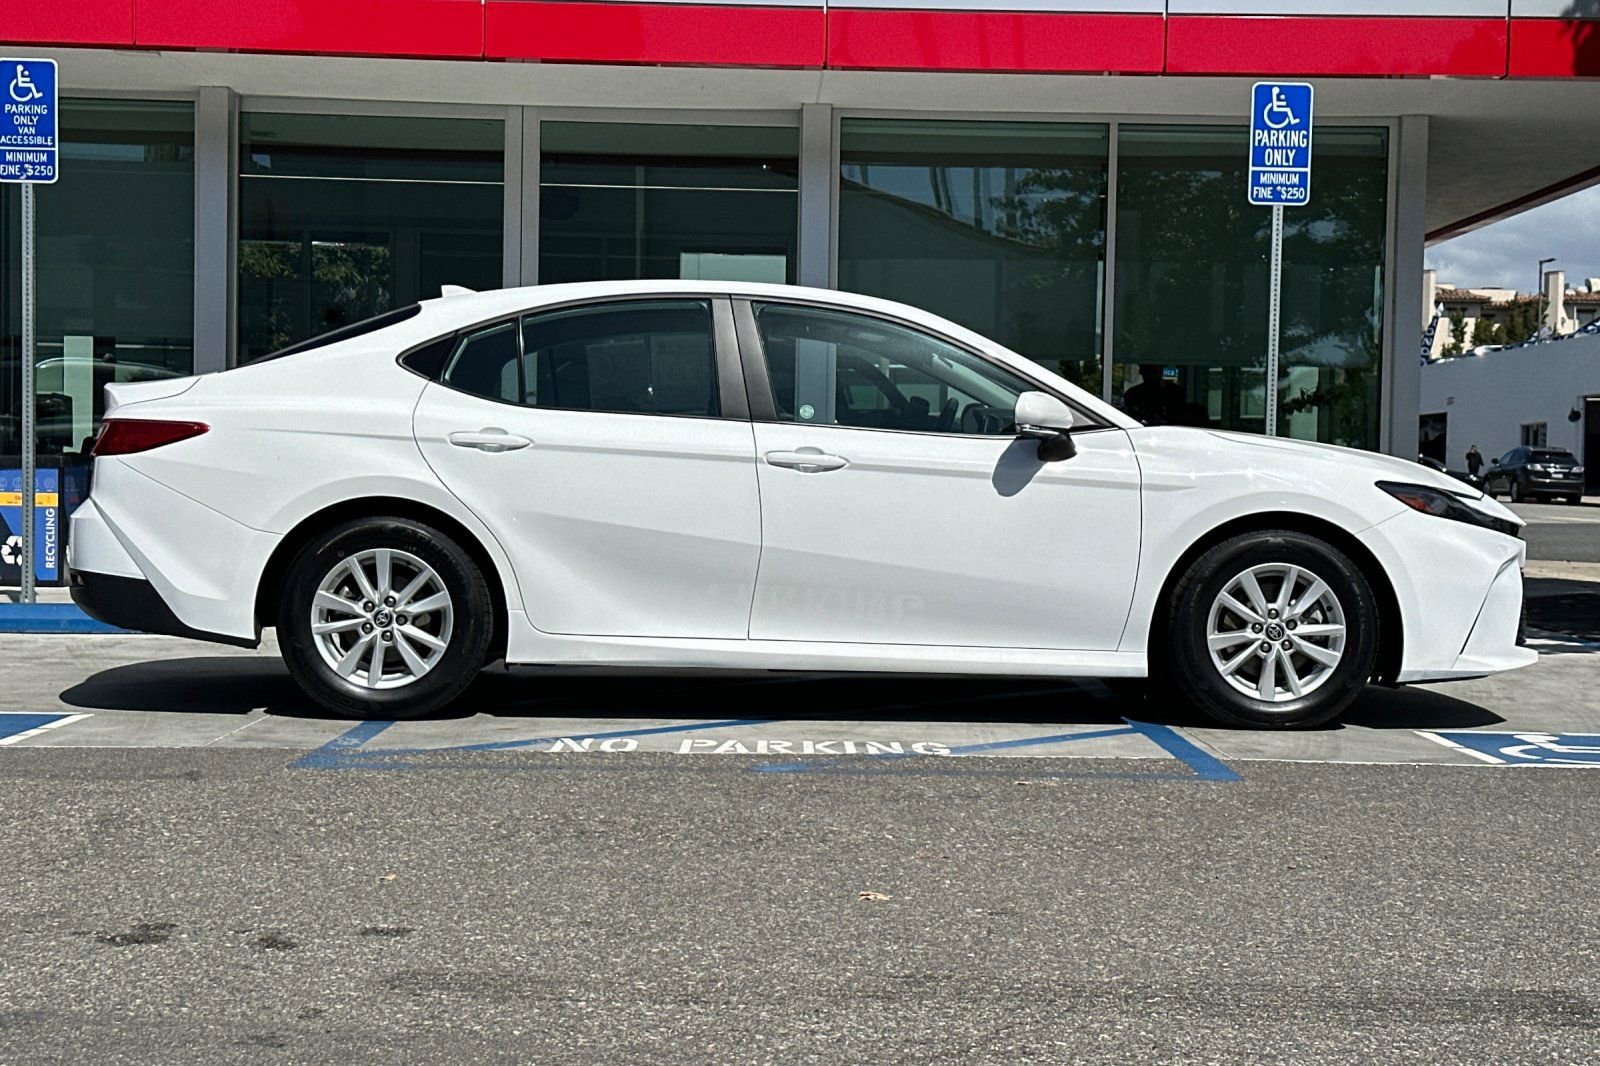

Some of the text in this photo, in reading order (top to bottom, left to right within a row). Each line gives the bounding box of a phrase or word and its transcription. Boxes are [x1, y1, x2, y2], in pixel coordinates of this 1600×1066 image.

[4, 104, 48, 115] PARKING
[13, 115, 39, 125] ONLY
[18, 126, 36, 135] VAN
[0, 135, 53, 146] ACCESSIBLE
[1254, 129, 1308, 148] PARKING
[5, 151, 48, 163] MINIMUM
[1264, 148, 1297, 166] ONLY
[0, 164, 53, 176] FINE $250
[1259, 172, 1300, 185] MINIMUM
[1253, 186, 1305, 200] FINE $250
[45, 508, 56, 569] RECYCLING
[549, 737, 952, 756] NO PARKING
